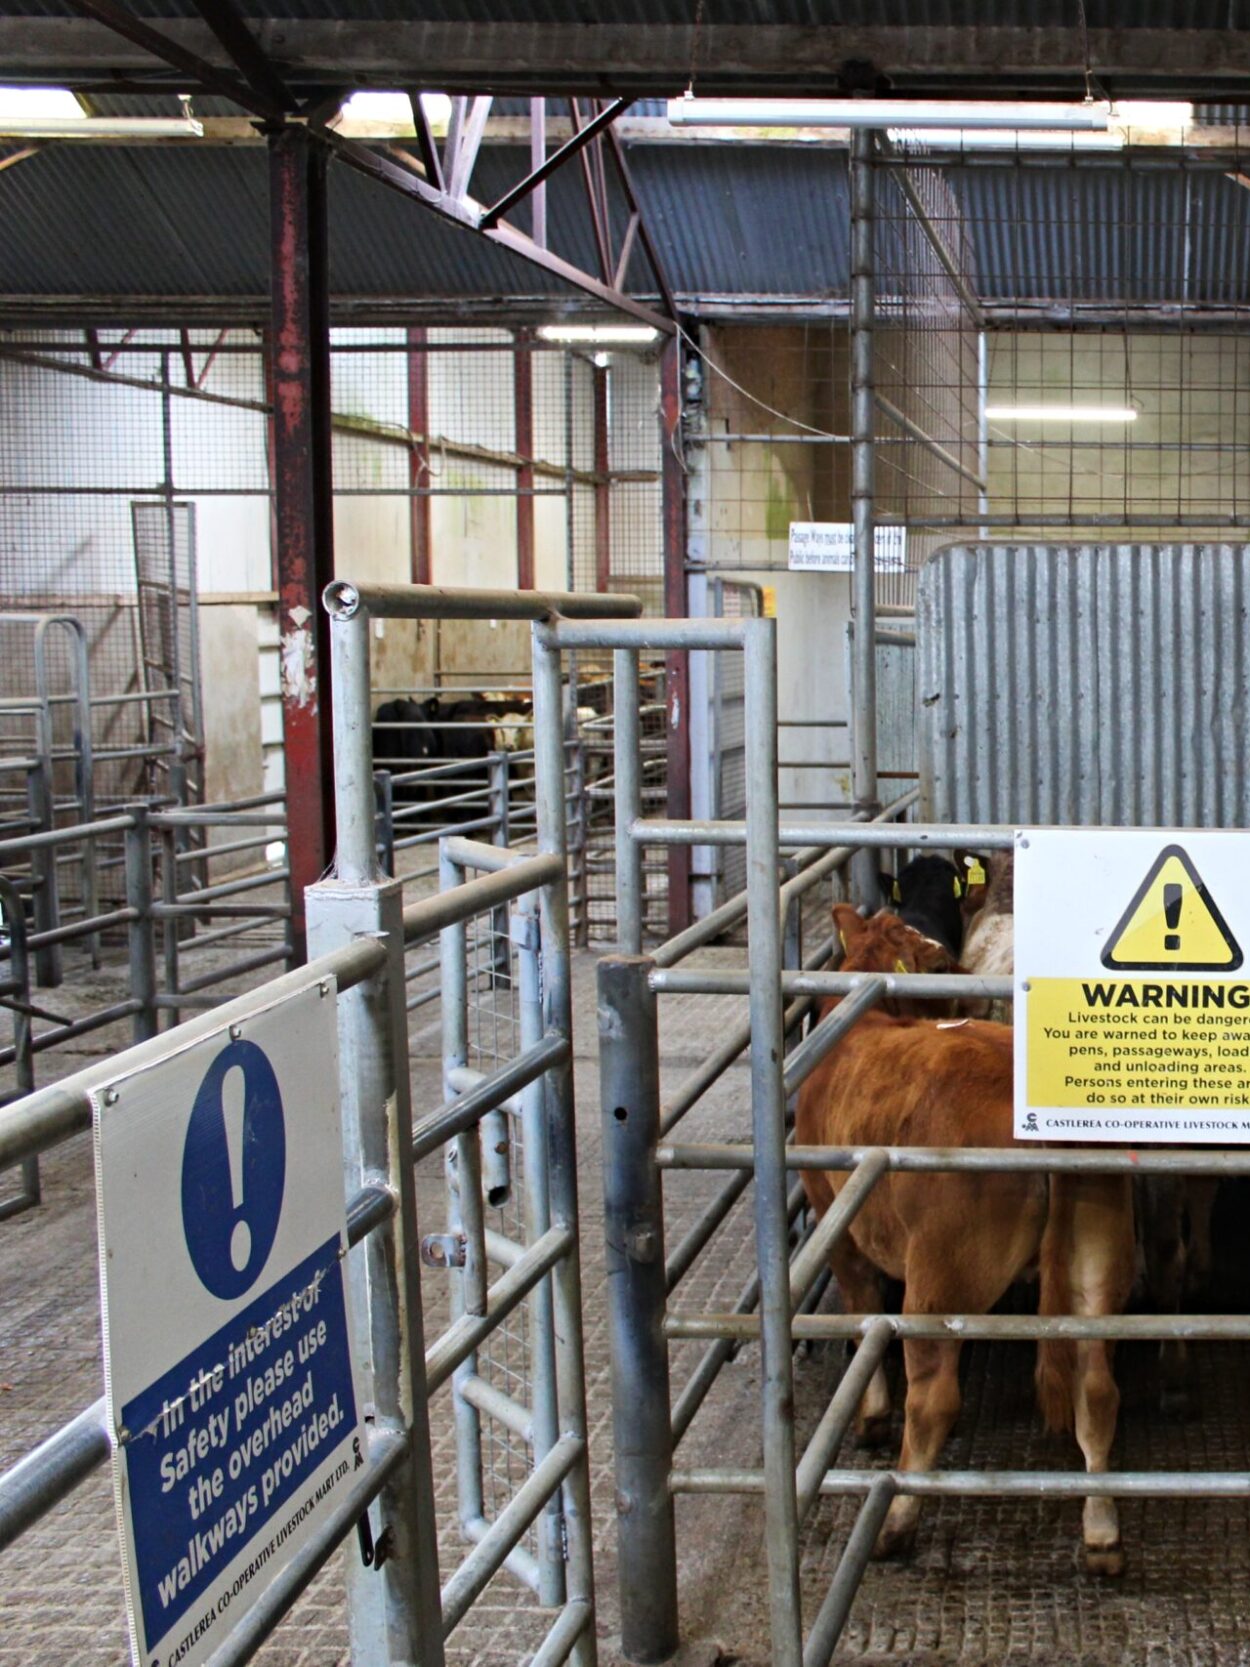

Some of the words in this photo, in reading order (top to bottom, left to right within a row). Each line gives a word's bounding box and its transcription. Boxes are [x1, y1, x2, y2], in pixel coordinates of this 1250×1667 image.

[1068, 1012, 1138, 1024] Livestock
[1142, 1015, 1168, 1024] can
[1173, 1012, 1191, 1025] be
[1043, 1027, 1070, 1039] You
[1075, 1030, 1098, 1040] are
[1103, 1029, 1157, 1040] warned
[1162, 1030, 1177, 1041] to
[1182, 1029, 1217, 1043] keep
[1069, 1045, 1108, 1057] pens,
[1112, 1046, 1213, 1059] passageways,
[1094, 1060, 1121, 1072] and
[1126, 1060, 1199, 1074] unloading
[1203, 1063, 1247, 1073] areas.
[1064, 1076, 1122, 1088] Persons
[1126, 1077, 1188, 1090] entering
[1193, 1077, 1232, 1089] these
[1086, 1092, 1105, 1104] do
[1110, 1095, 1127, 1104] so
[1131, 1093, 1145, 1104] at
[1150, 1092, 1185, 1104] their
[1188, 1095, 1219, 1105] own
[1046, 1119, 1102, 1128] CASTLEREA
[1105, 1119, 1181, 1129] CO-OPERATIVE
[1183, 1121, 1238, 1130] LIVESTOCK
[161, 1397, 185, 1438] In
[189, 1366, 224, 1413] the
[228, 1292, 300, 1380] interest
[160, 1407, 229, 1493] Safety
[234, 1349, 294, 1432] please
[298, 1320, 327, 1364] use
[188, 1467, 224, 1520] the
[229, 1370, 314, 1479] overhead
[158, 1485, 258, 1608] walkways
[261, 1392, 345, 1507] provided.
[168, 1608, 217, 1667] CASTLEREA
[217, 1540, 275, 1614] CO-OPERATIVE
[275, 1496, 315, 1549] LIVESTOCK
[314, 1475, 336, 1505] MART
[334, 1460, 350, 1485] LTD.
